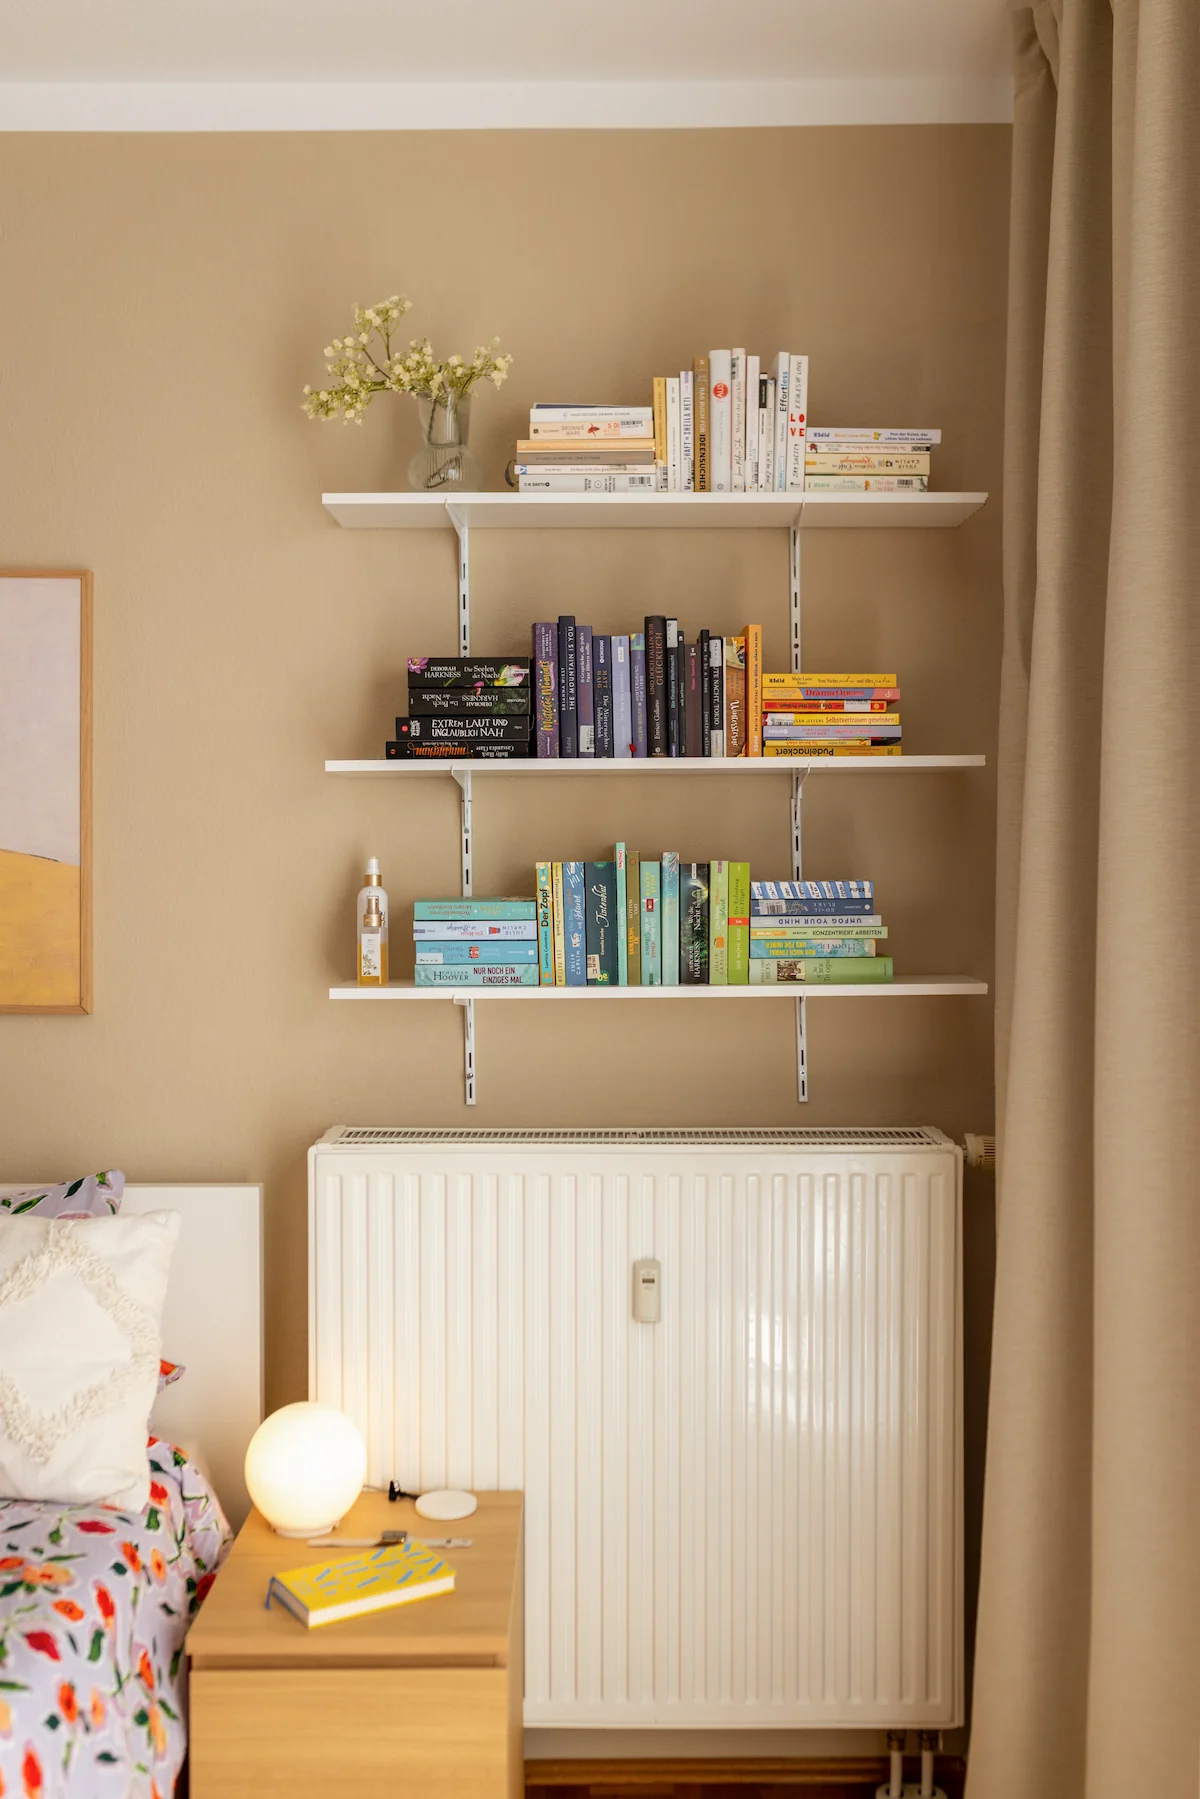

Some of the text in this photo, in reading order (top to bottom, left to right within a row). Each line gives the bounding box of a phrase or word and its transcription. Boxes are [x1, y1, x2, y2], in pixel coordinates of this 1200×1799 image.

[779, 371, 788, 412] Effortless
[654, 632, 664, 686] GLÜCKLICH
[431, 720, 464, 728] EXTREM
[466, 719, 491, 728] LAUT
[431, 728, 479, 737] UNGLAUBLICH
[480, 728, 504, 738] NAH
[539, 888, 551, 927] Der Zopf
[591, 884, 610, 928] Tintenblut
[688, 915, 694, 924] Wo
[510, 976, 523, 984] MAL
